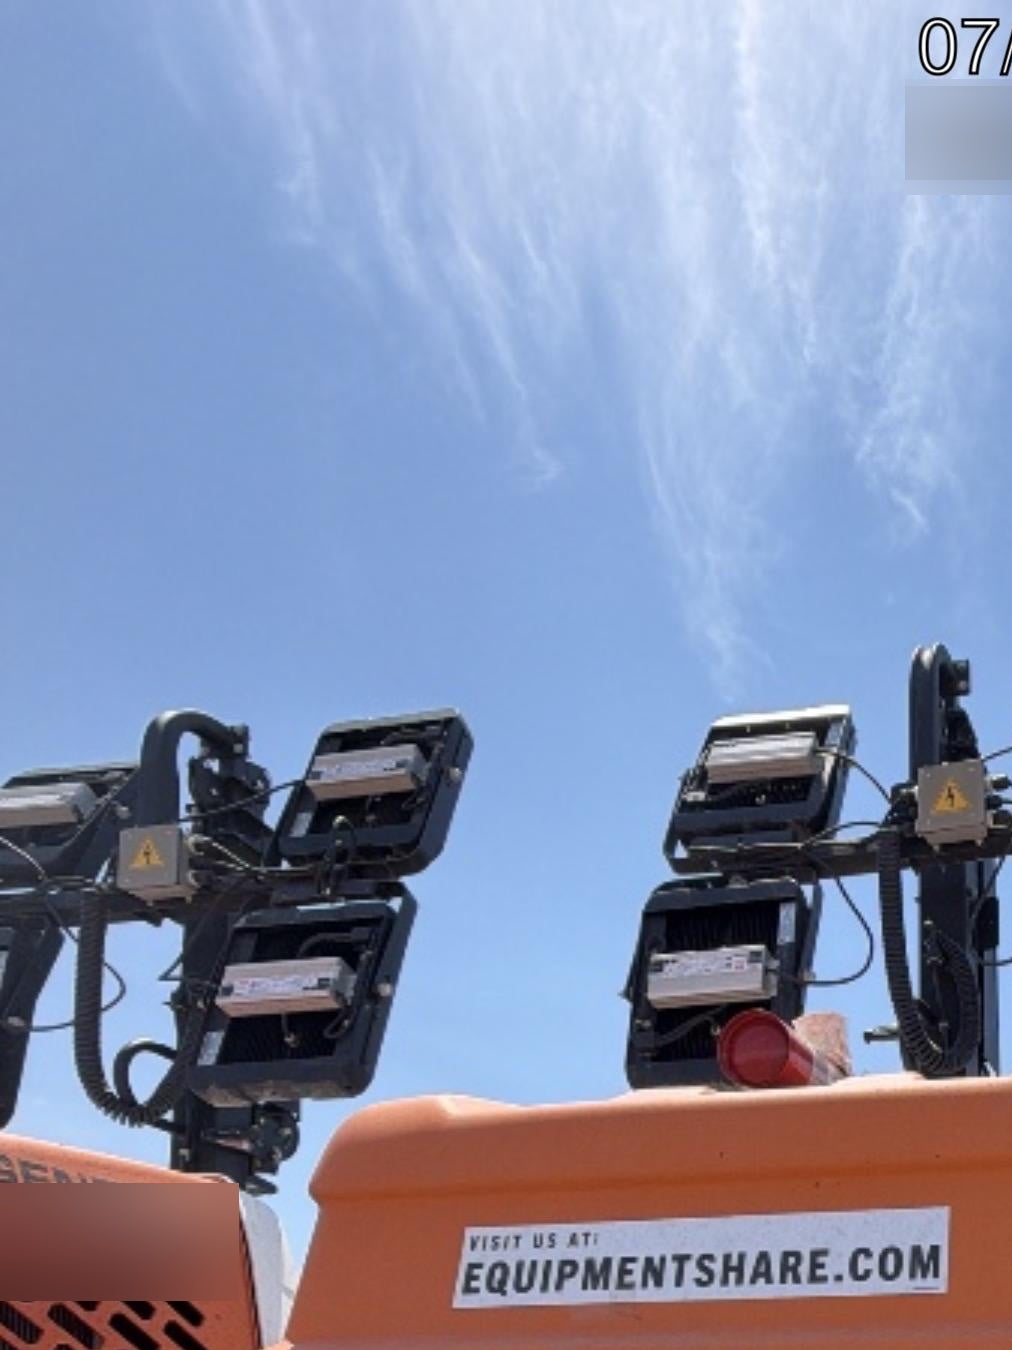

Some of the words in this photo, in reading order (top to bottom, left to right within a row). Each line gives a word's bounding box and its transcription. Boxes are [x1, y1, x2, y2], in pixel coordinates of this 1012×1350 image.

[469, 1234, 523, 1252] VISIT
[532, 1232, 557, 1249] US
[461, 1244, 941, 1296] EQUIPMENTSHARE.COM
